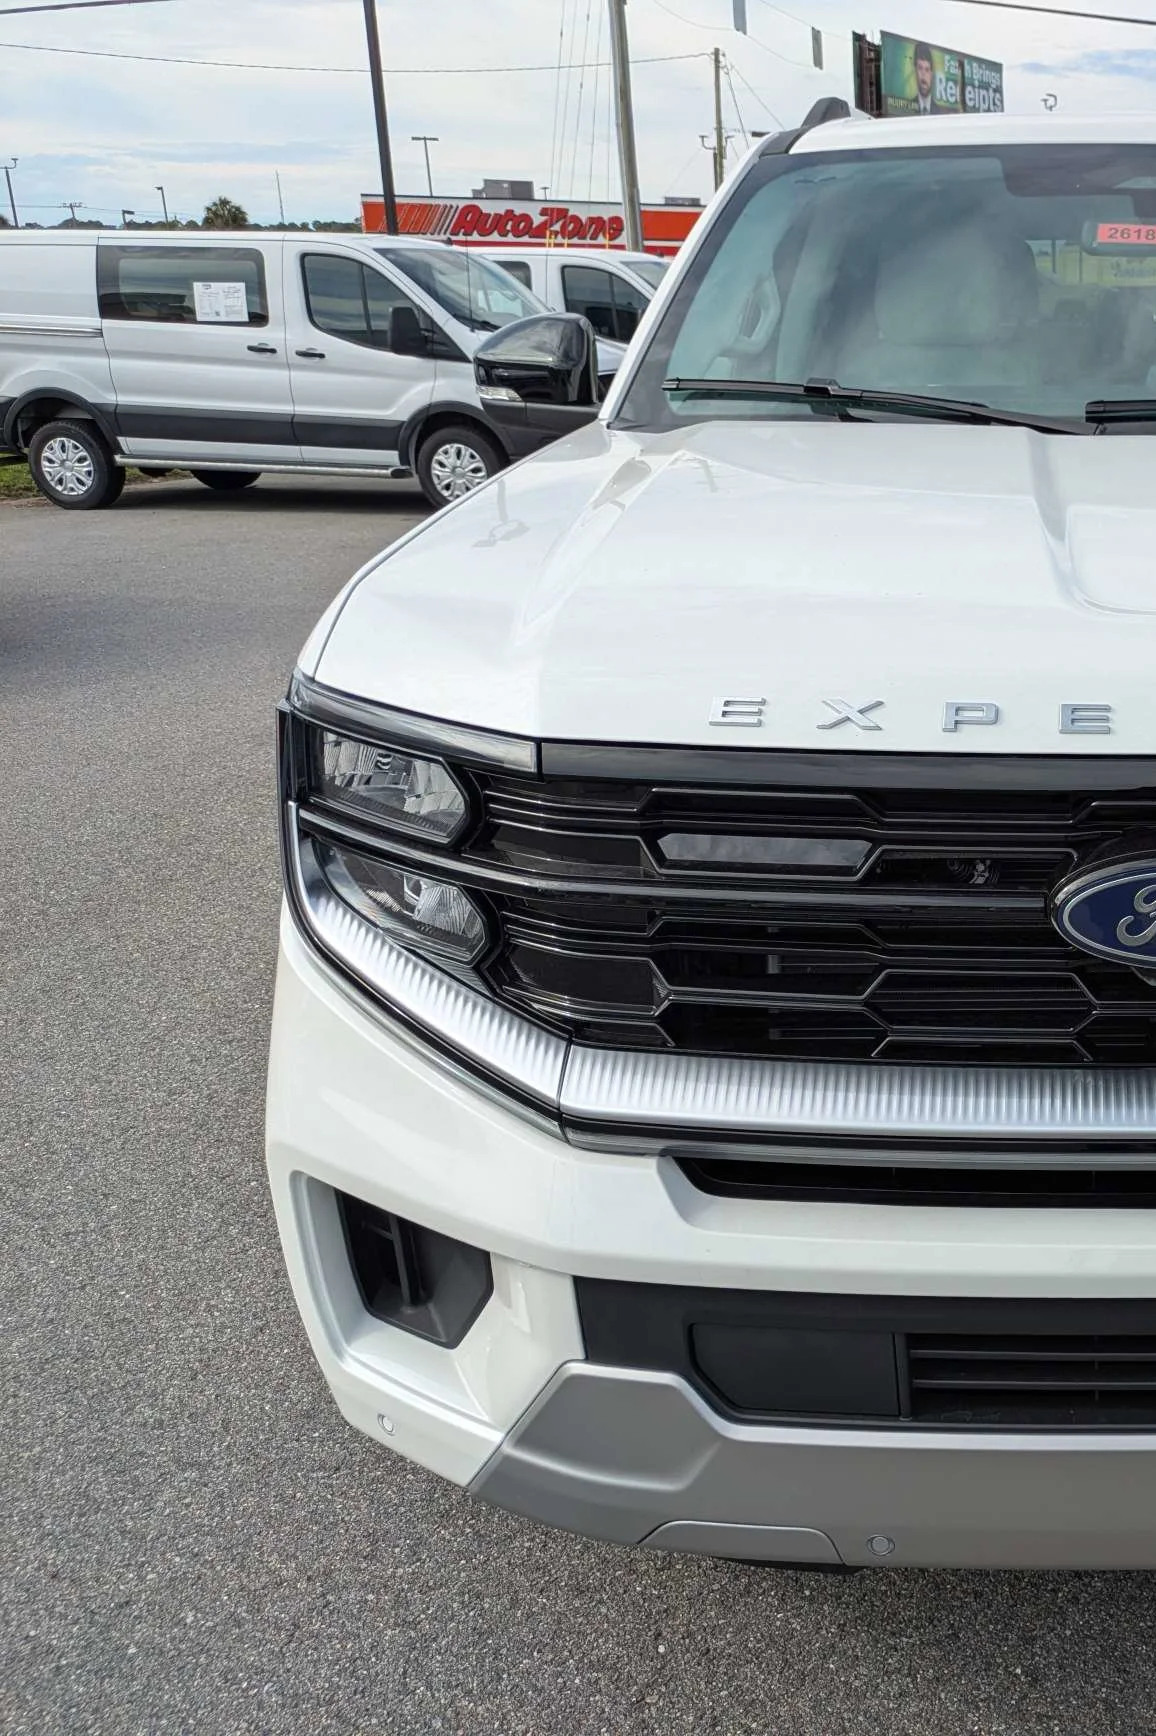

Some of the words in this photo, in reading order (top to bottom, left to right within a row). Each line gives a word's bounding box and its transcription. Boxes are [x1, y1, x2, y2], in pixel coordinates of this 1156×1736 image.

[944, 54, 971, 78] Faih
[972, 61, 1001, 89] Brings
[450, 203, 624, 242] AutoZone
